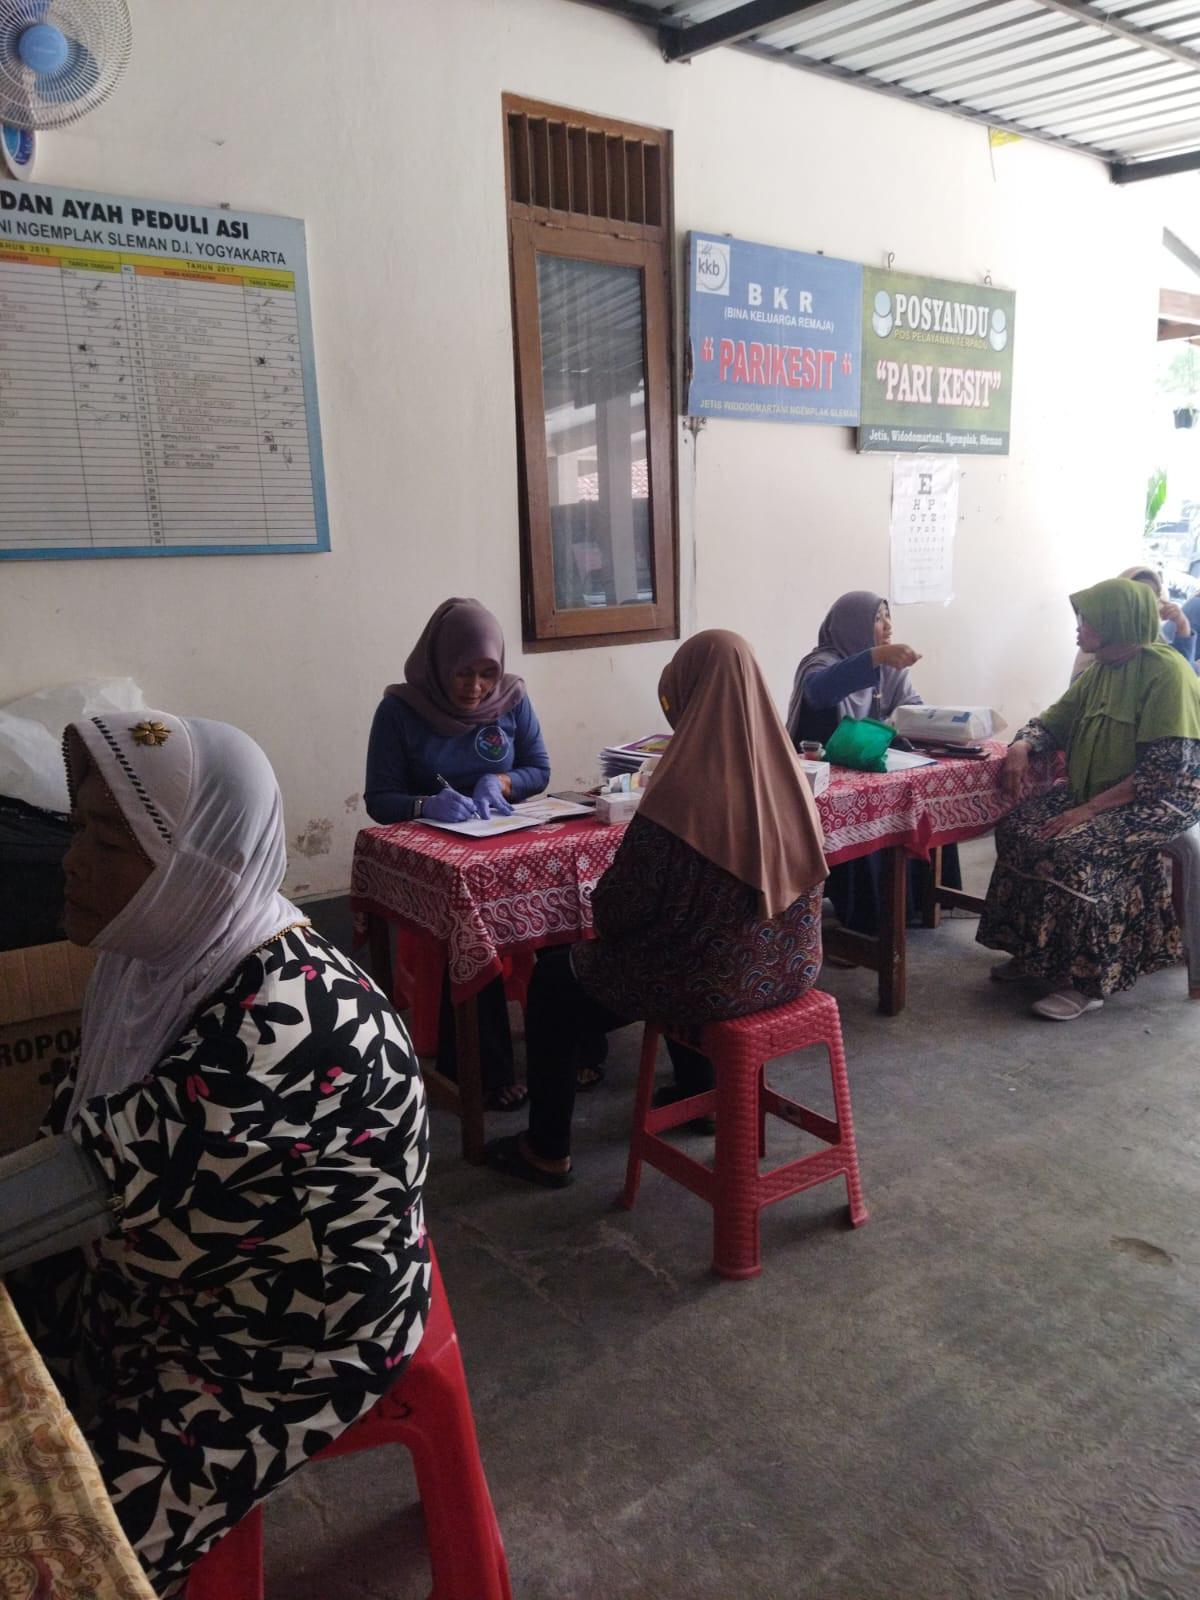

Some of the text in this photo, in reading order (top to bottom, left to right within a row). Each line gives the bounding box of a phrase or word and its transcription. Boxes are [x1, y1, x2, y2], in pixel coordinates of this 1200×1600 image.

[0, 190, 250, 240] DAN AYAH PEDULI ASI
[17, 220, 104, 245] NGEMPLAK
[108, 232, 168, 251] SLEMAN
[172, 239, 193, 255] D.I.
[196, 242, 287, 266] YOGYAKARTA
[186, 262, 235, 273] TAHUN 2017
[698, 258, 720, 277] kkb
[724, 306, 835, 334] (BINA KELUARGA REMAJA)
[894, 293, 990, 338] POSYANDU
[911, 332, 955, 346] PELAYANAN
[719, 338, 837, 391] PARIKESIT
[700, 399, 722, 410] JETIS
[918, 473, 933, 495] E
[0, 1027, 82, 1068] ROPO
